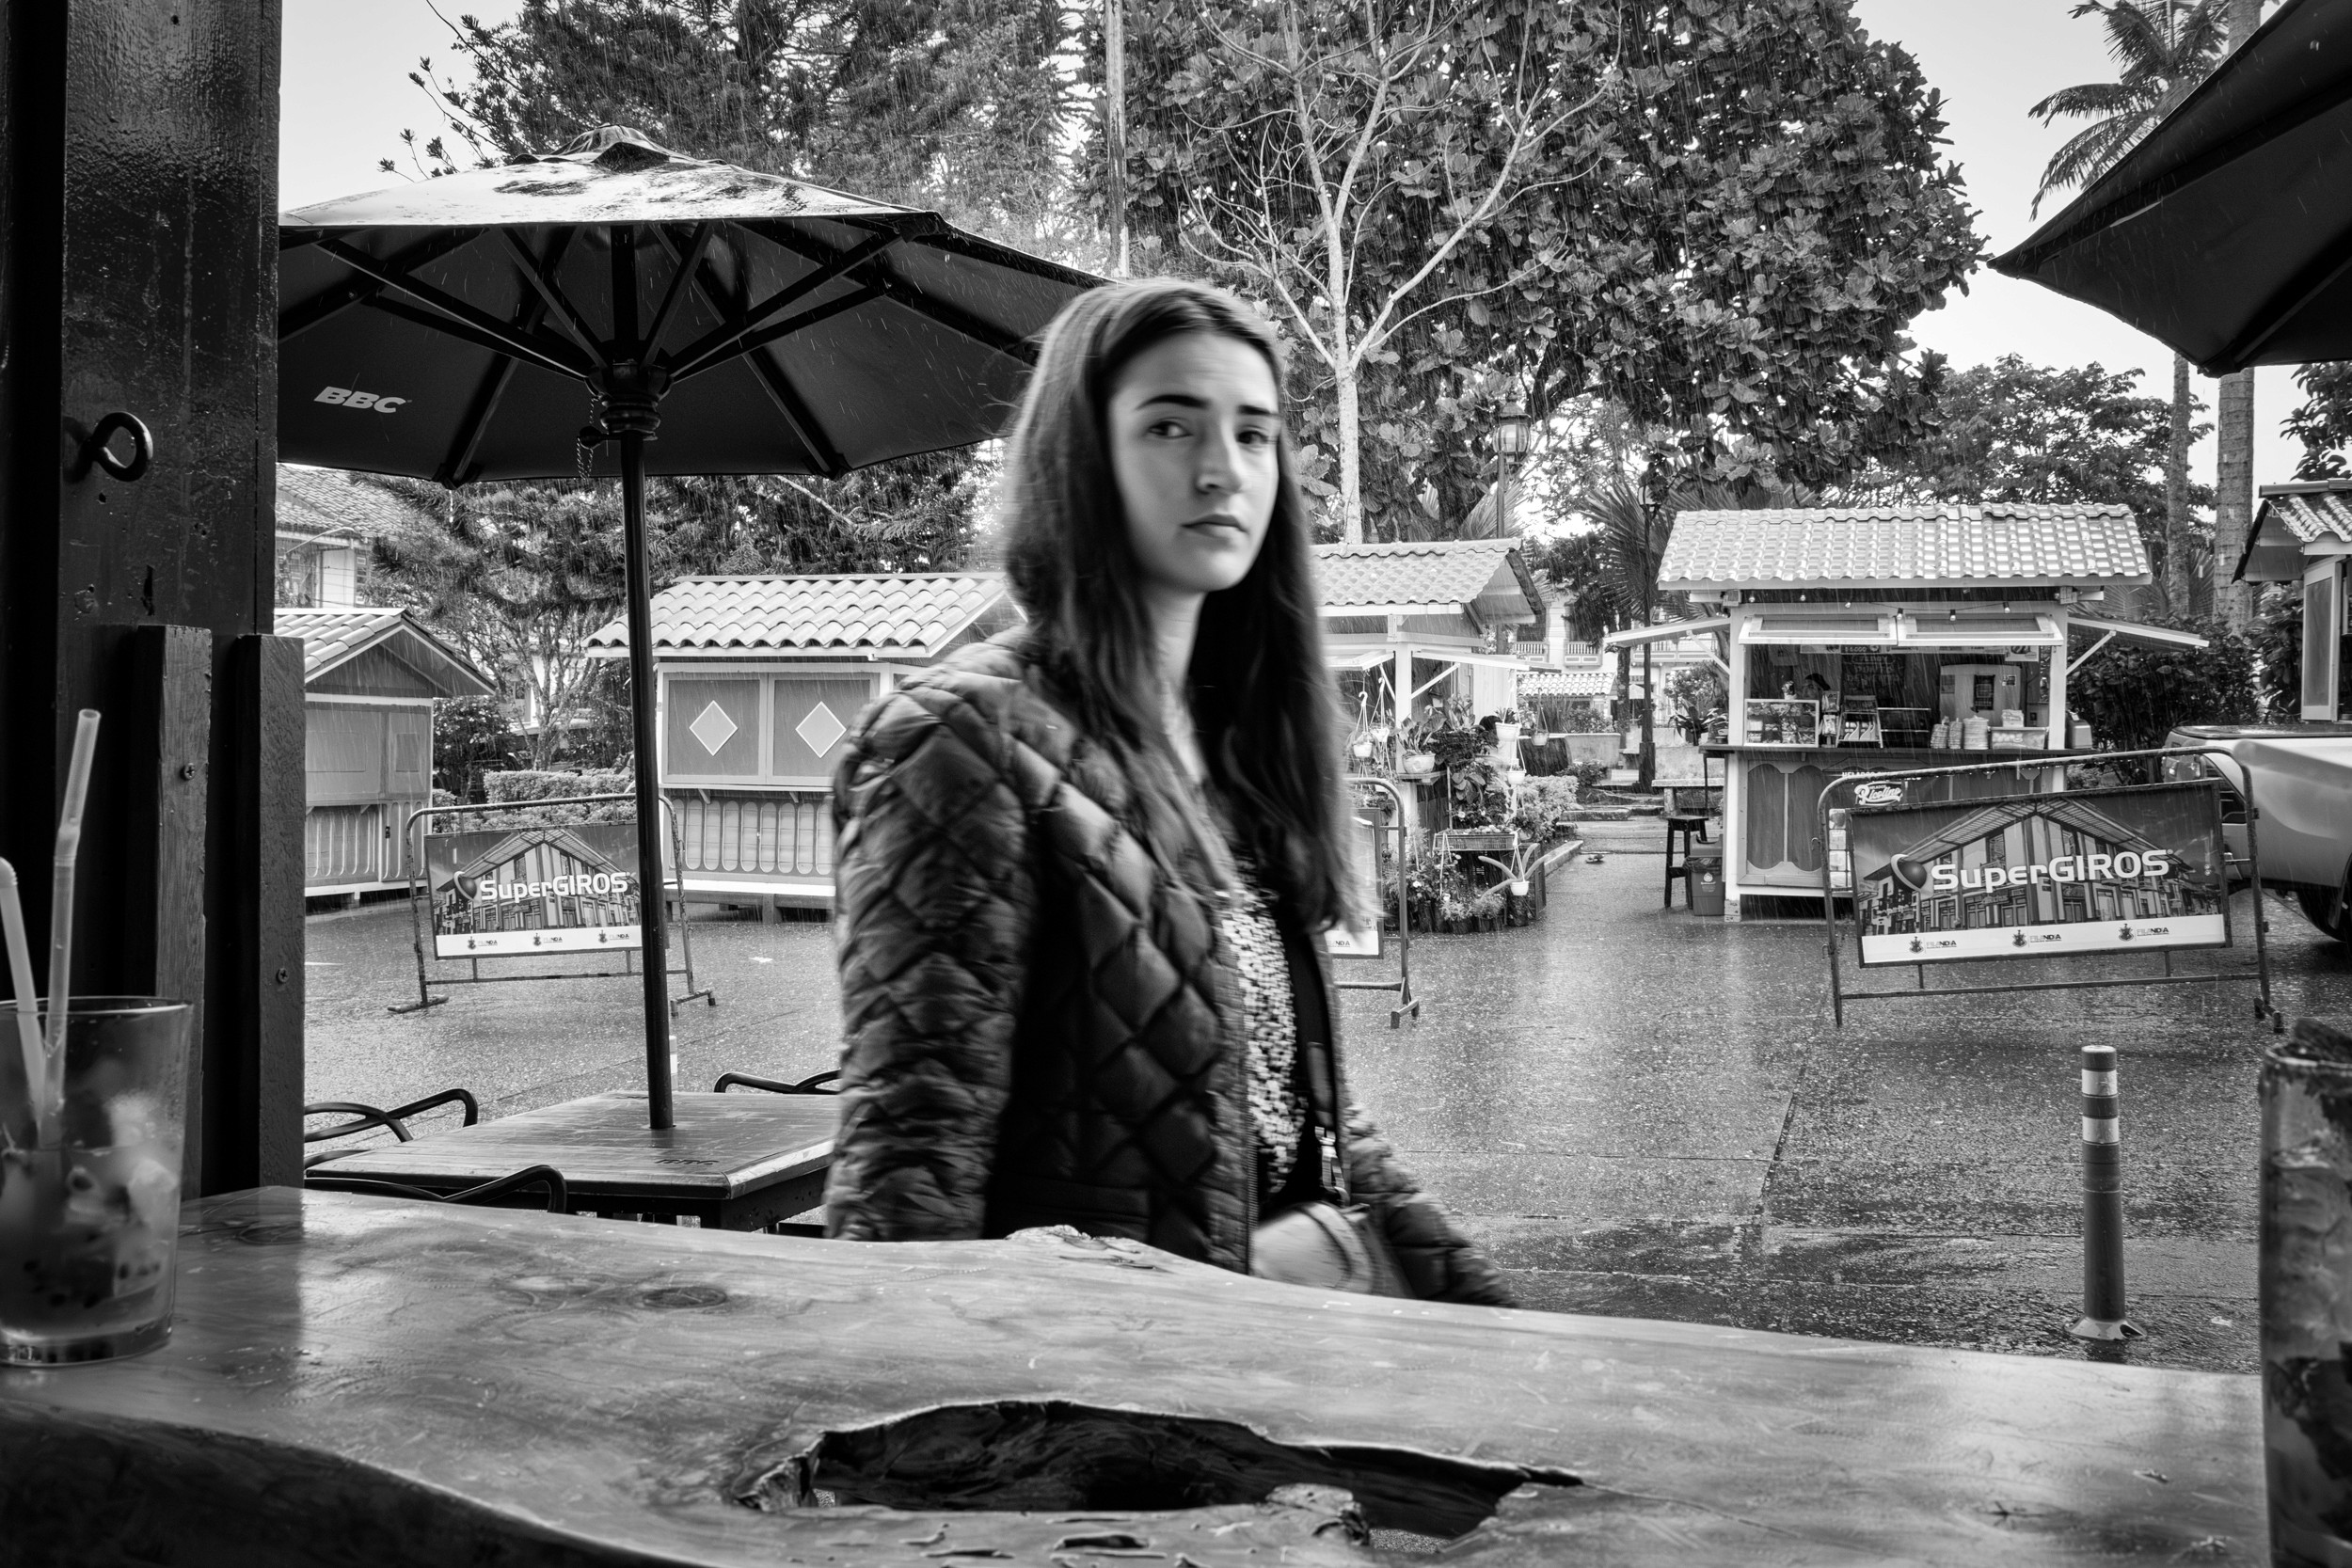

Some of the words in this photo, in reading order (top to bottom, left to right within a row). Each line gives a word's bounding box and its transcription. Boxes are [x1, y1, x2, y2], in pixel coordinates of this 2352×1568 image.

[313, 386, 406, 414] BBC
[479, 871, 628, 904] SuperGIROS
[1931, 849, 2169, 894] SuperGIROS
